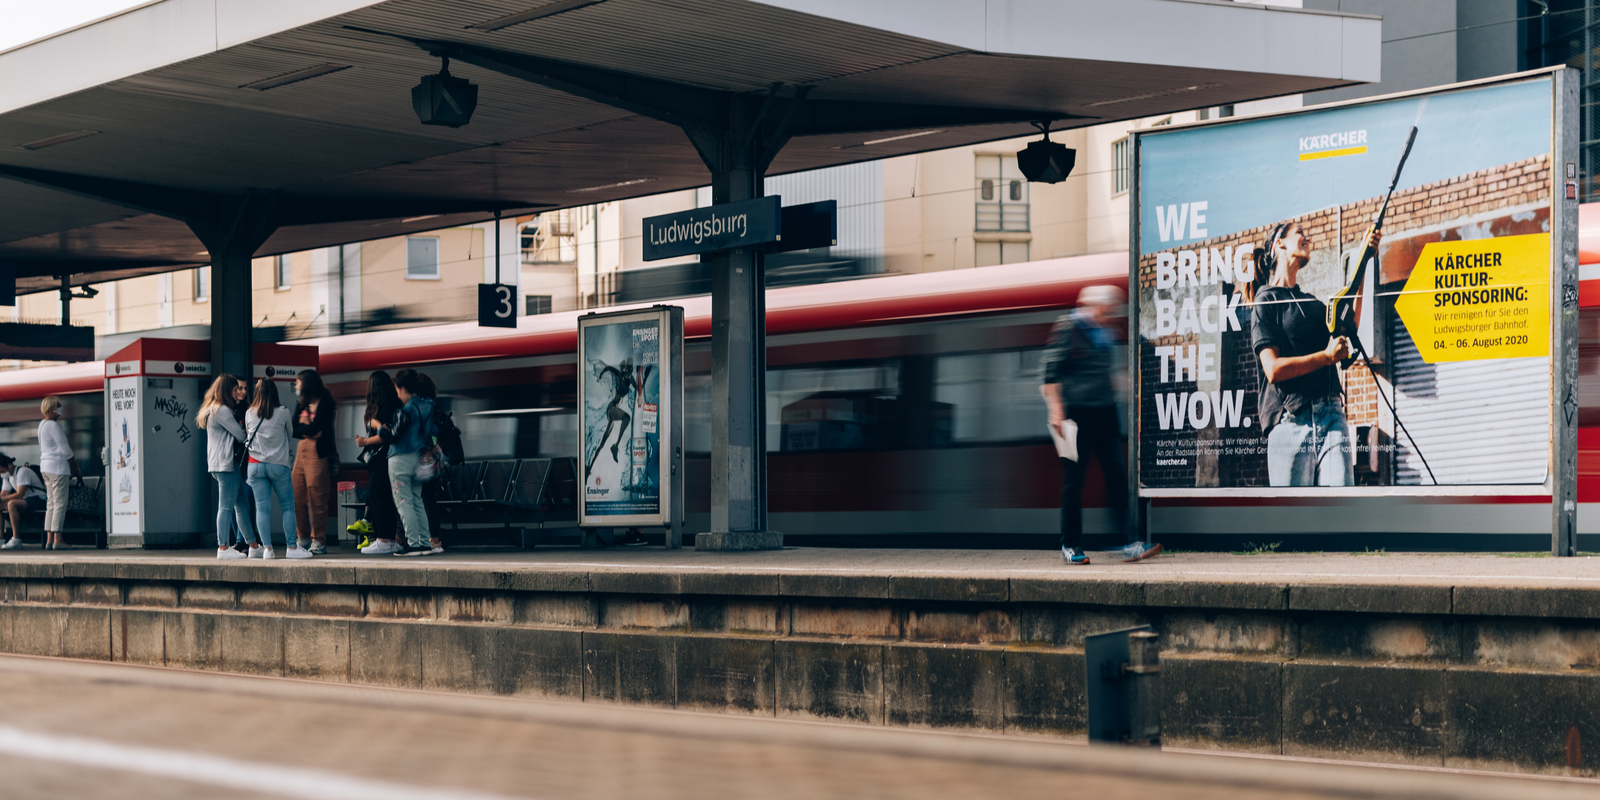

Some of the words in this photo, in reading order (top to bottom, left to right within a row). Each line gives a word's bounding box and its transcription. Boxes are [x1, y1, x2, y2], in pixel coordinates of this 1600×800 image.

[1300, 130, 1367, 151] KÄRCHER
[650, 214, 746, 245] Ludwigsburg
[1156, 201, 1208, 242] WE
[1157, 244, 1255, 290] BRING
[1435, 252, 1502, 271] KÄRCHER
[1435, 272, 1493, 289] KULTUR-
[495, 286, 512, 318] 3
[1434, 287, 1528, 307] SPONSORING:
[1157, 293, 1242, 336] BACK
[1434, 312, 1448, 320] Wir
[1450, 310, 1482, 320] reinigen
[1485, 308, 1497, 317] für
[1499, 307, 1511, 316] Sie
[1513, 307, 1528, 315] den
[1434, 323, 1491, 334] Ludwigsburger
[1494, 320, 1528, 330] Bahnhof.
[1434, 340, 1447, 349] 04.
[1456, 339, 1469, 348] 06.
[1472, 337, 1502, 348] August
[1505, 335, 1528, 345] 2020
[1155, 343, 1216, 383] THE
[113, 389, 123, 399] HEUTE
[125, 388, 136, 398] NOCH
[115, 401, 123, 410] VIEL
[123, 400, 134, 410] VOR?
[1155, 389, 1252, 430] WOW.
[1176, 448, 1204, 456] Radstation
[1235, 446, 1255, 454] Kärcher
[1341, 444, 1370, 453] kosnfrei
[1236, 438, 1258, 446] reinigen
[587, 487, 609, 496] Ensinger
